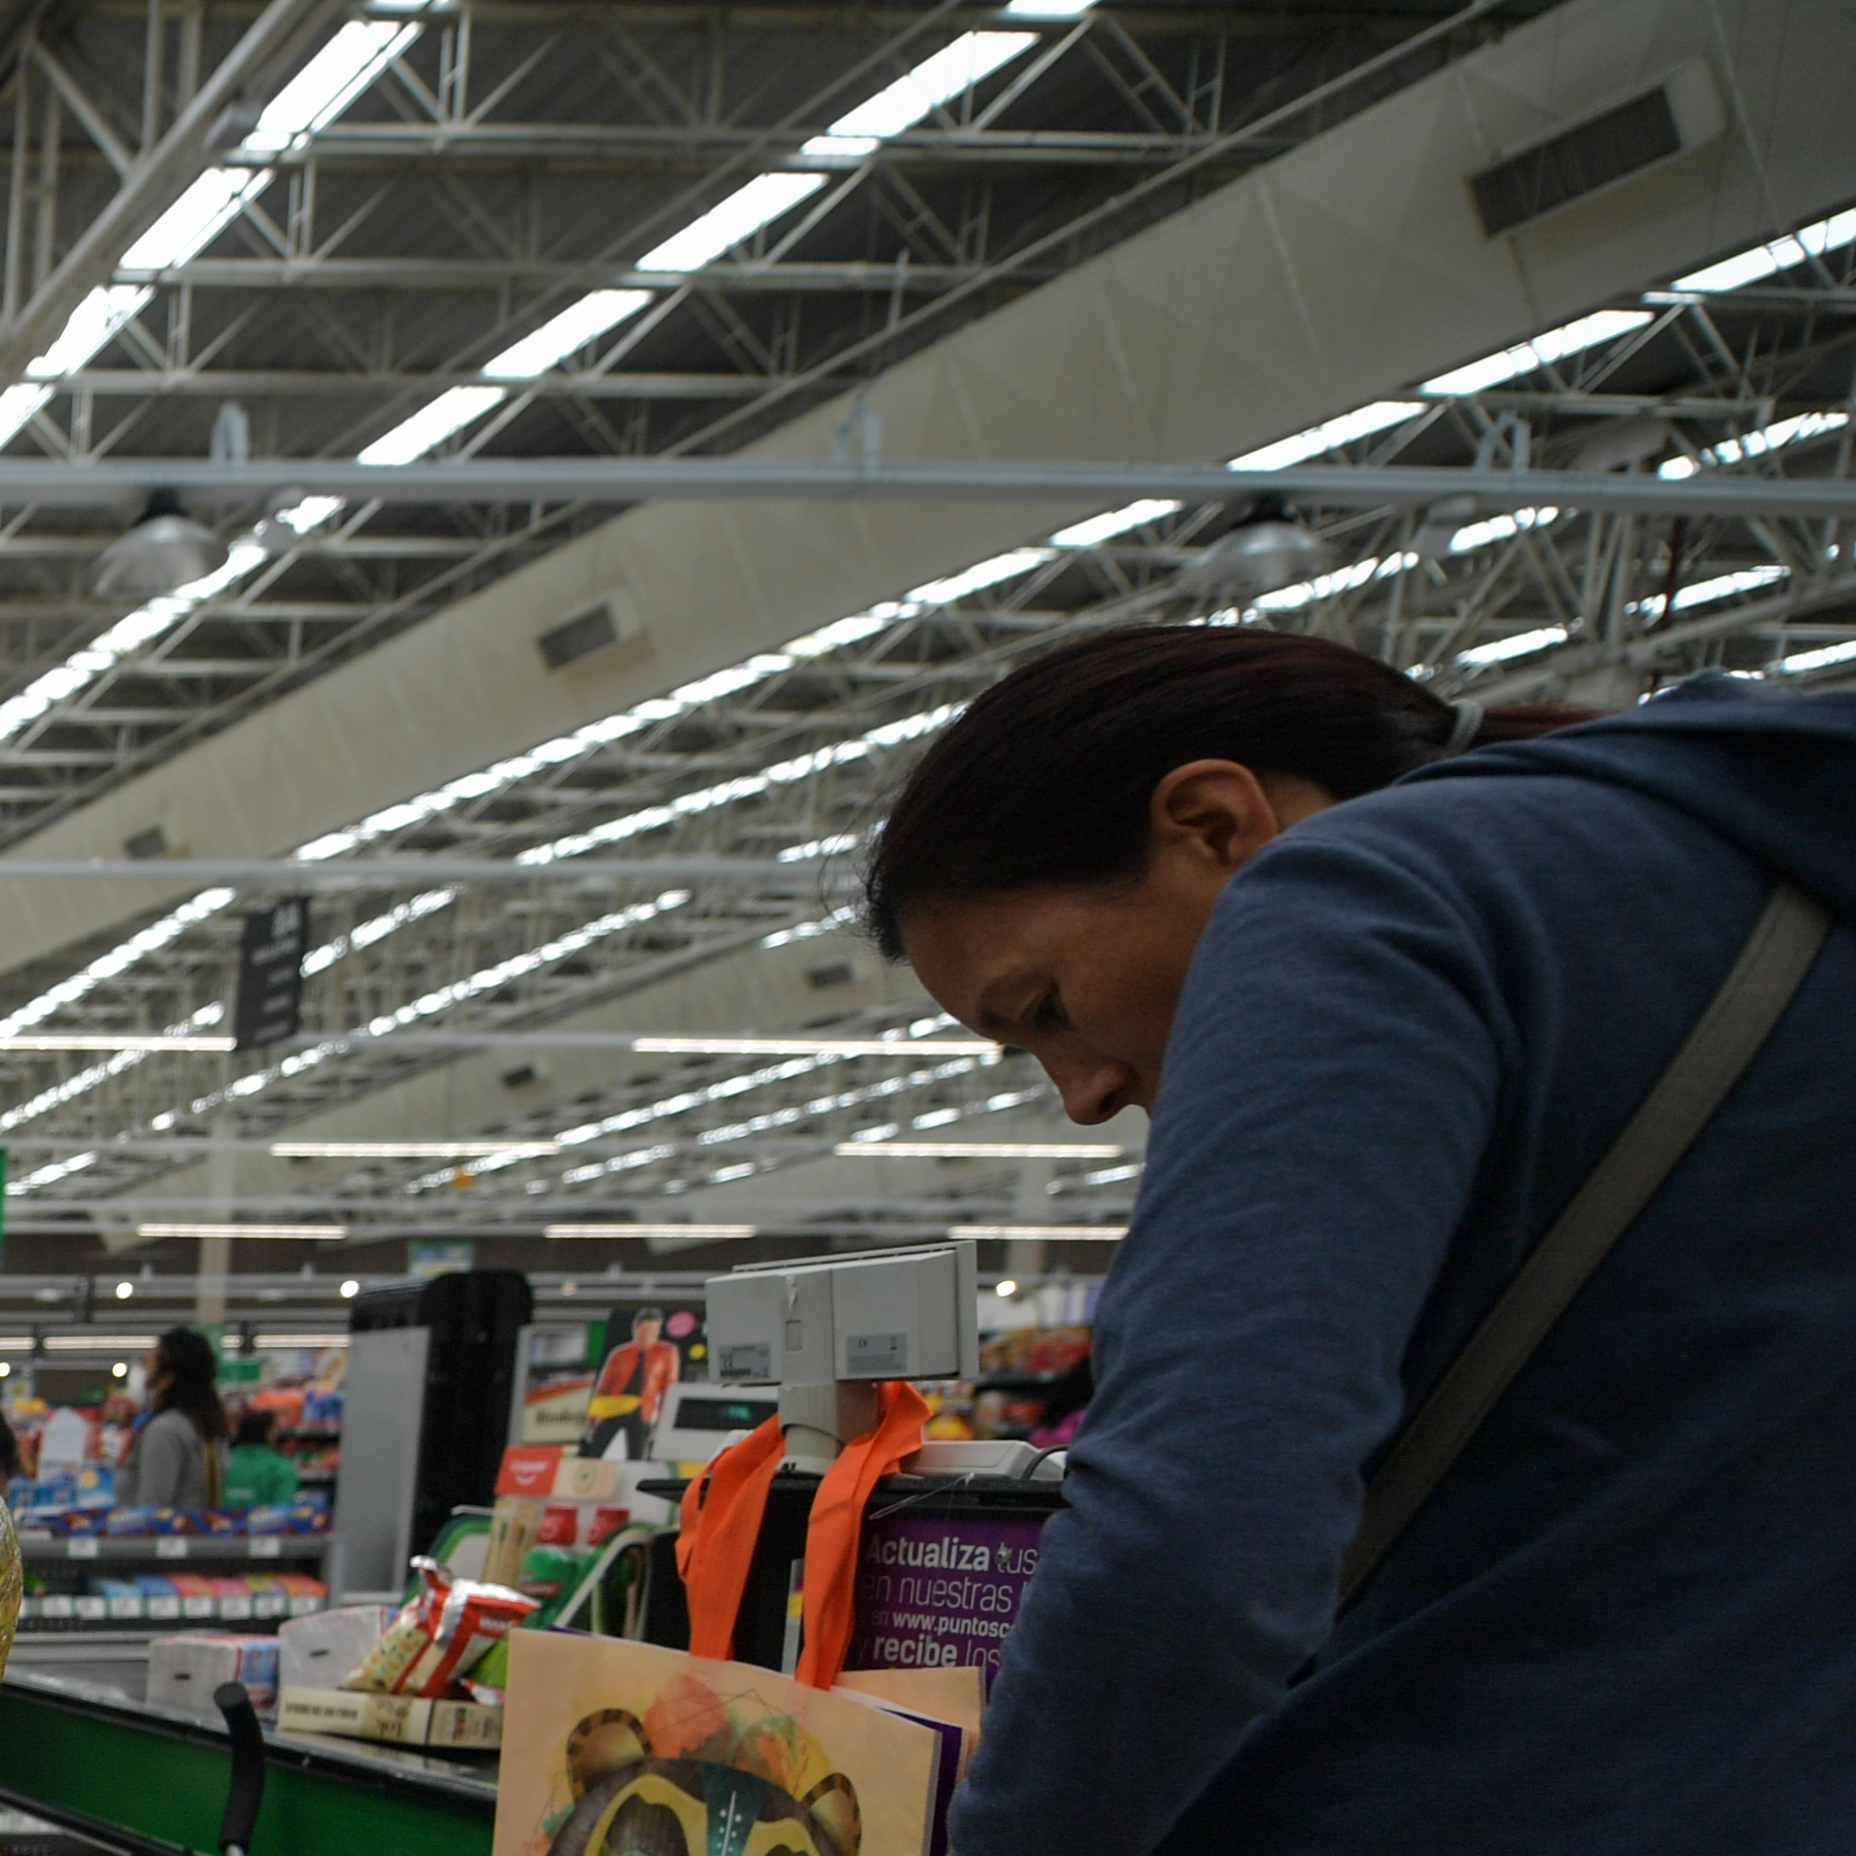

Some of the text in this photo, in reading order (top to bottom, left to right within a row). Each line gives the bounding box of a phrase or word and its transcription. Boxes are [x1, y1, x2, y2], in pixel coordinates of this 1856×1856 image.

[865, 1535, 990, 1571] Actualiza
[898, 1576, 1013, 1613] nuestras
[892, 1611, 1014, 1639] www.puntosc
[873, 1633, 958, 1668] recibe
